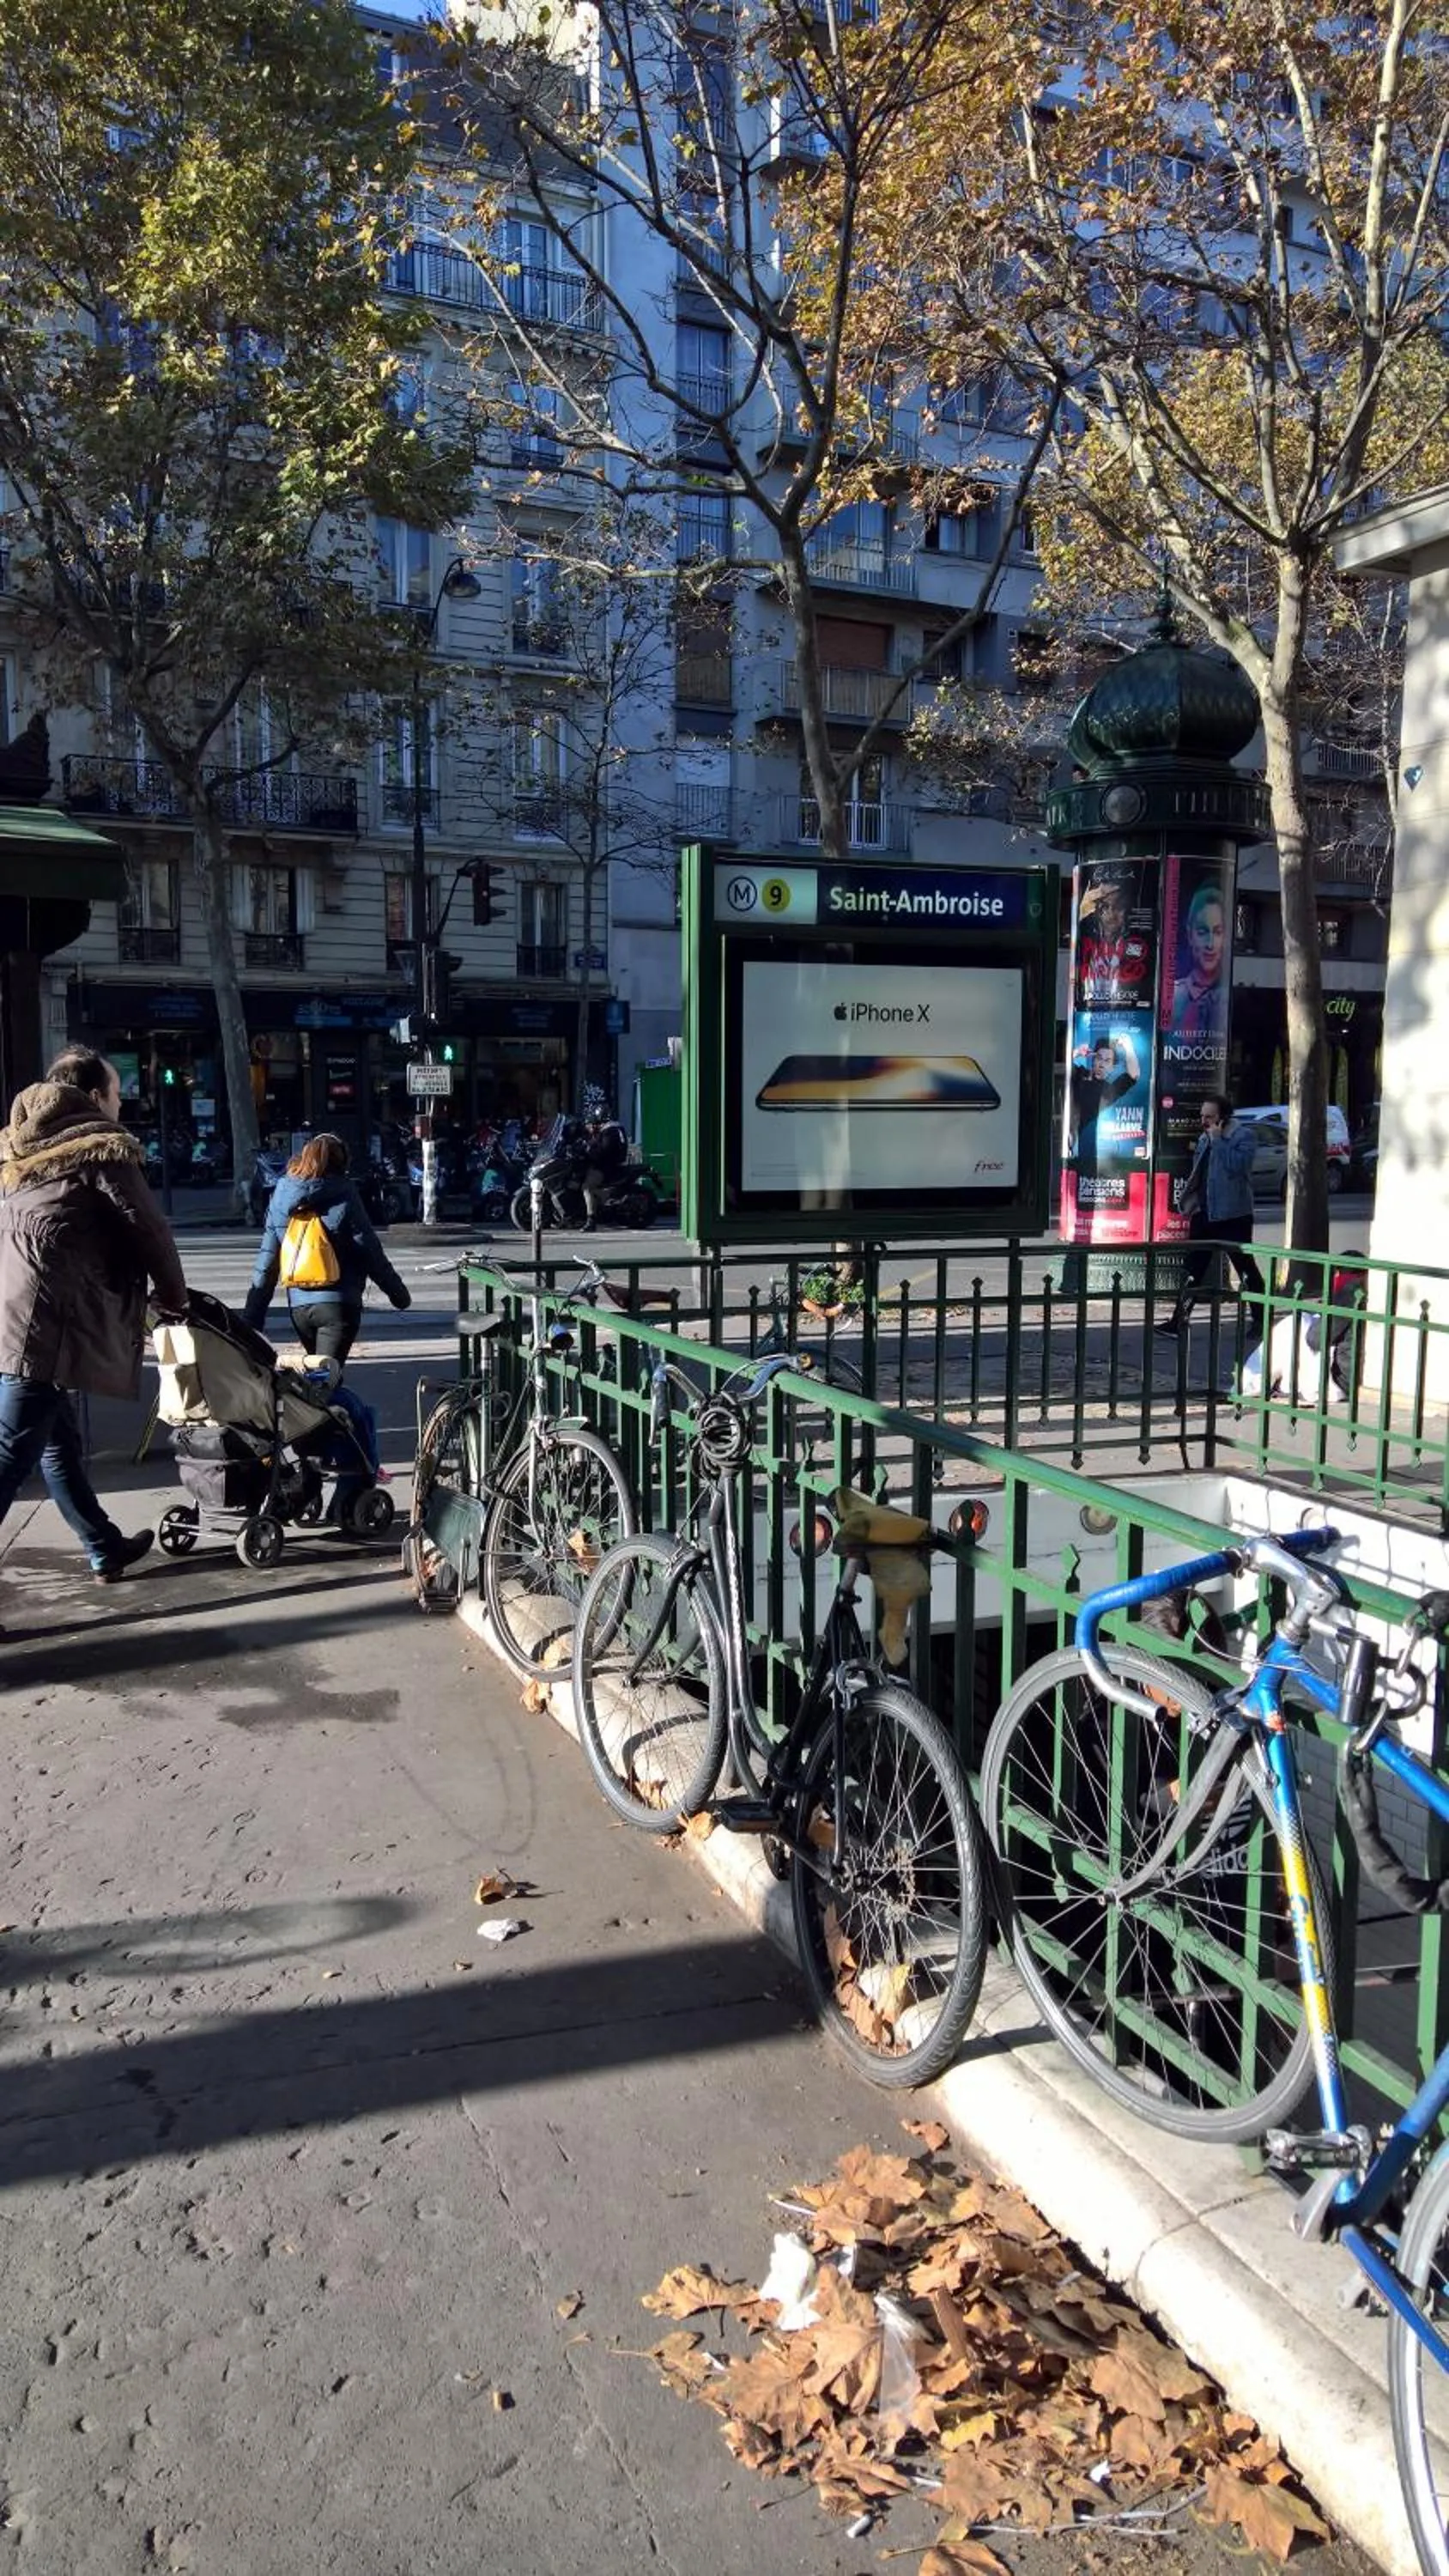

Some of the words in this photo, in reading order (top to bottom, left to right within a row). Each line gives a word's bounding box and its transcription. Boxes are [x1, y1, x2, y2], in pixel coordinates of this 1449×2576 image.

[768, 887, 782, 906] 9
[829, 886, 1004, 916] Saint-Ambroise
[850, 1003, 914, 1023] iPhone
[917, 1005, 931, 1023] X
[1325, 996, 1357, 1022] city
[1115, 1106, 1144, 1121] YANN
[973, 1159, 1004, 1172] free
